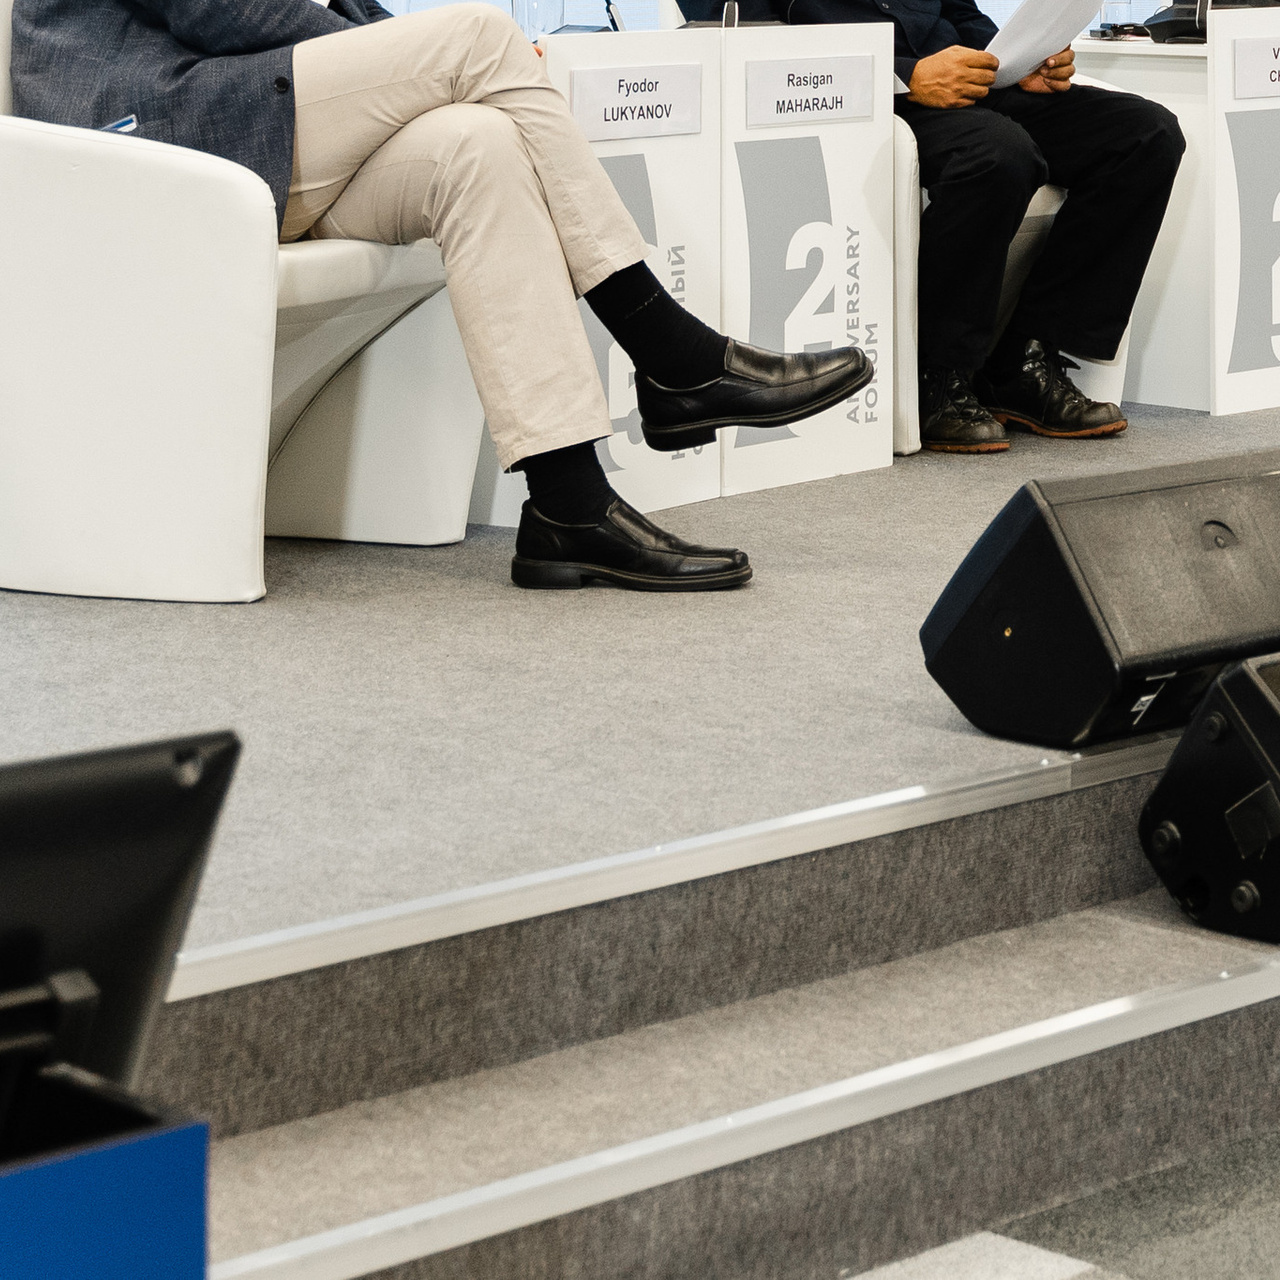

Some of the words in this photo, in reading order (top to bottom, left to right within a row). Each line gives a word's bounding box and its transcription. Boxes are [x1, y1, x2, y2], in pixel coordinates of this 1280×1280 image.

[617, 79, 659, 96] Fyodor
[787, 72, 833, 89] Rasigan
[603, 104, 673, 122] LUKYANOV
[776, 95, 844, 114] MAHARAJH
